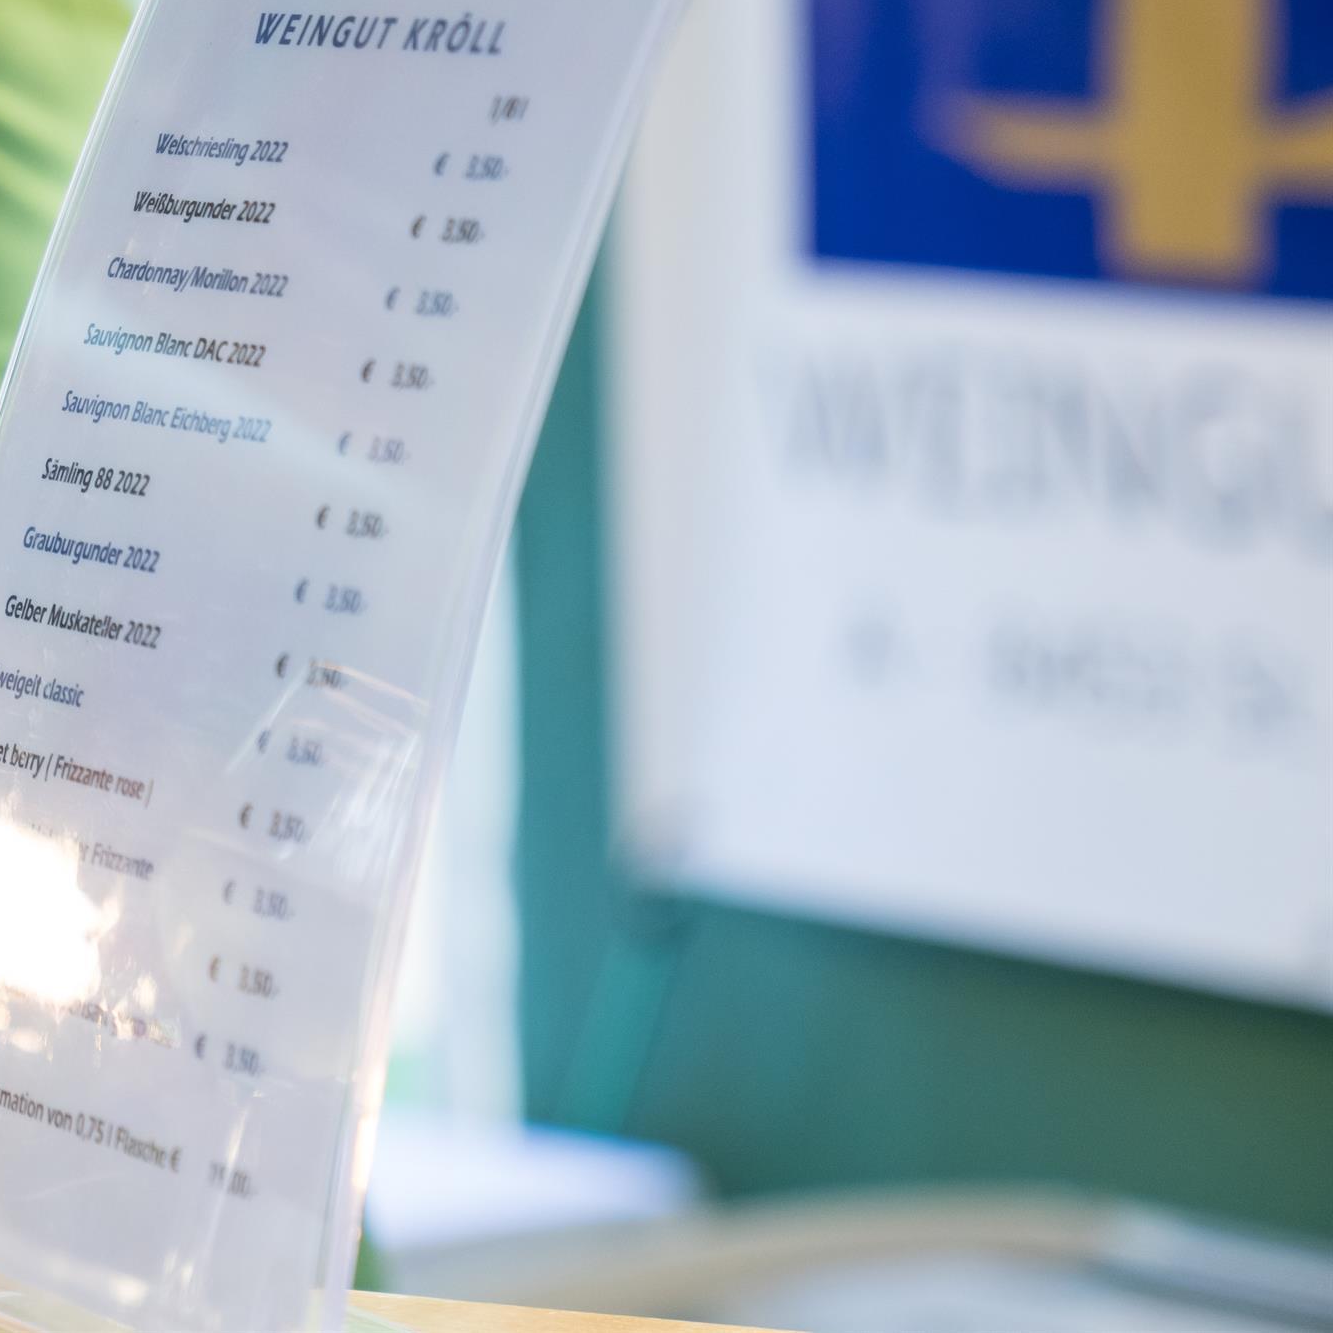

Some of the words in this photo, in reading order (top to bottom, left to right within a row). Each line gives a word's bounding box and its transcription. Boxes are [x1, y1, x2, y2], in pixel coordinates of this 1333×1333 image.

[255, 13, 399, 49] WEINGUT
[402, 12, 507, 55] KRÖLL
[155, 133, 249, 166] Welschriesling
[250, 140, 288, 163] 2022
[133, 191, 236, 223] Weißburgunder
[236, 200, 276, 224] 2022
[107, 257, 249, 292] Chardonnay/Morillon
[249, 272, 288, 297] 2022
[83, 323, 153, 355] Sauvignon
[154, 332, 193, 358] Blanc
[193, 337, 228, 363] DAC
[227, 342, 266, 367] 2022
[62, 390, 130, 423] Sauvignon
[132, 401, 170, 428] Blanc
[170, 407, 232, 443] Eichberg
[232, 416, 272, 443] 2022
[41, 458, 93, 493] Sämling
[94, 467, 114, 490] 88
[113, 470, 150, 496] 2022
[23, 526, 123, 565] Grauburgunder
[123, 546, 160, 573] 2022
[5, 595, 47, 623] Gelber
[47, 604, 124, 641] Muskateller
[124, 621, 161, 649] 2022
[43, 679, 84, 707] classic
[10, 743, 45, 779] berry
[91, 842, 154, 880] Frizzante
[47, 1107, 73, 1132] von
[76, 1112, 105, 1145] 0,75
[114, 1126, 166, 1169] Flasche
[169, 1147, 182, 1174] €
